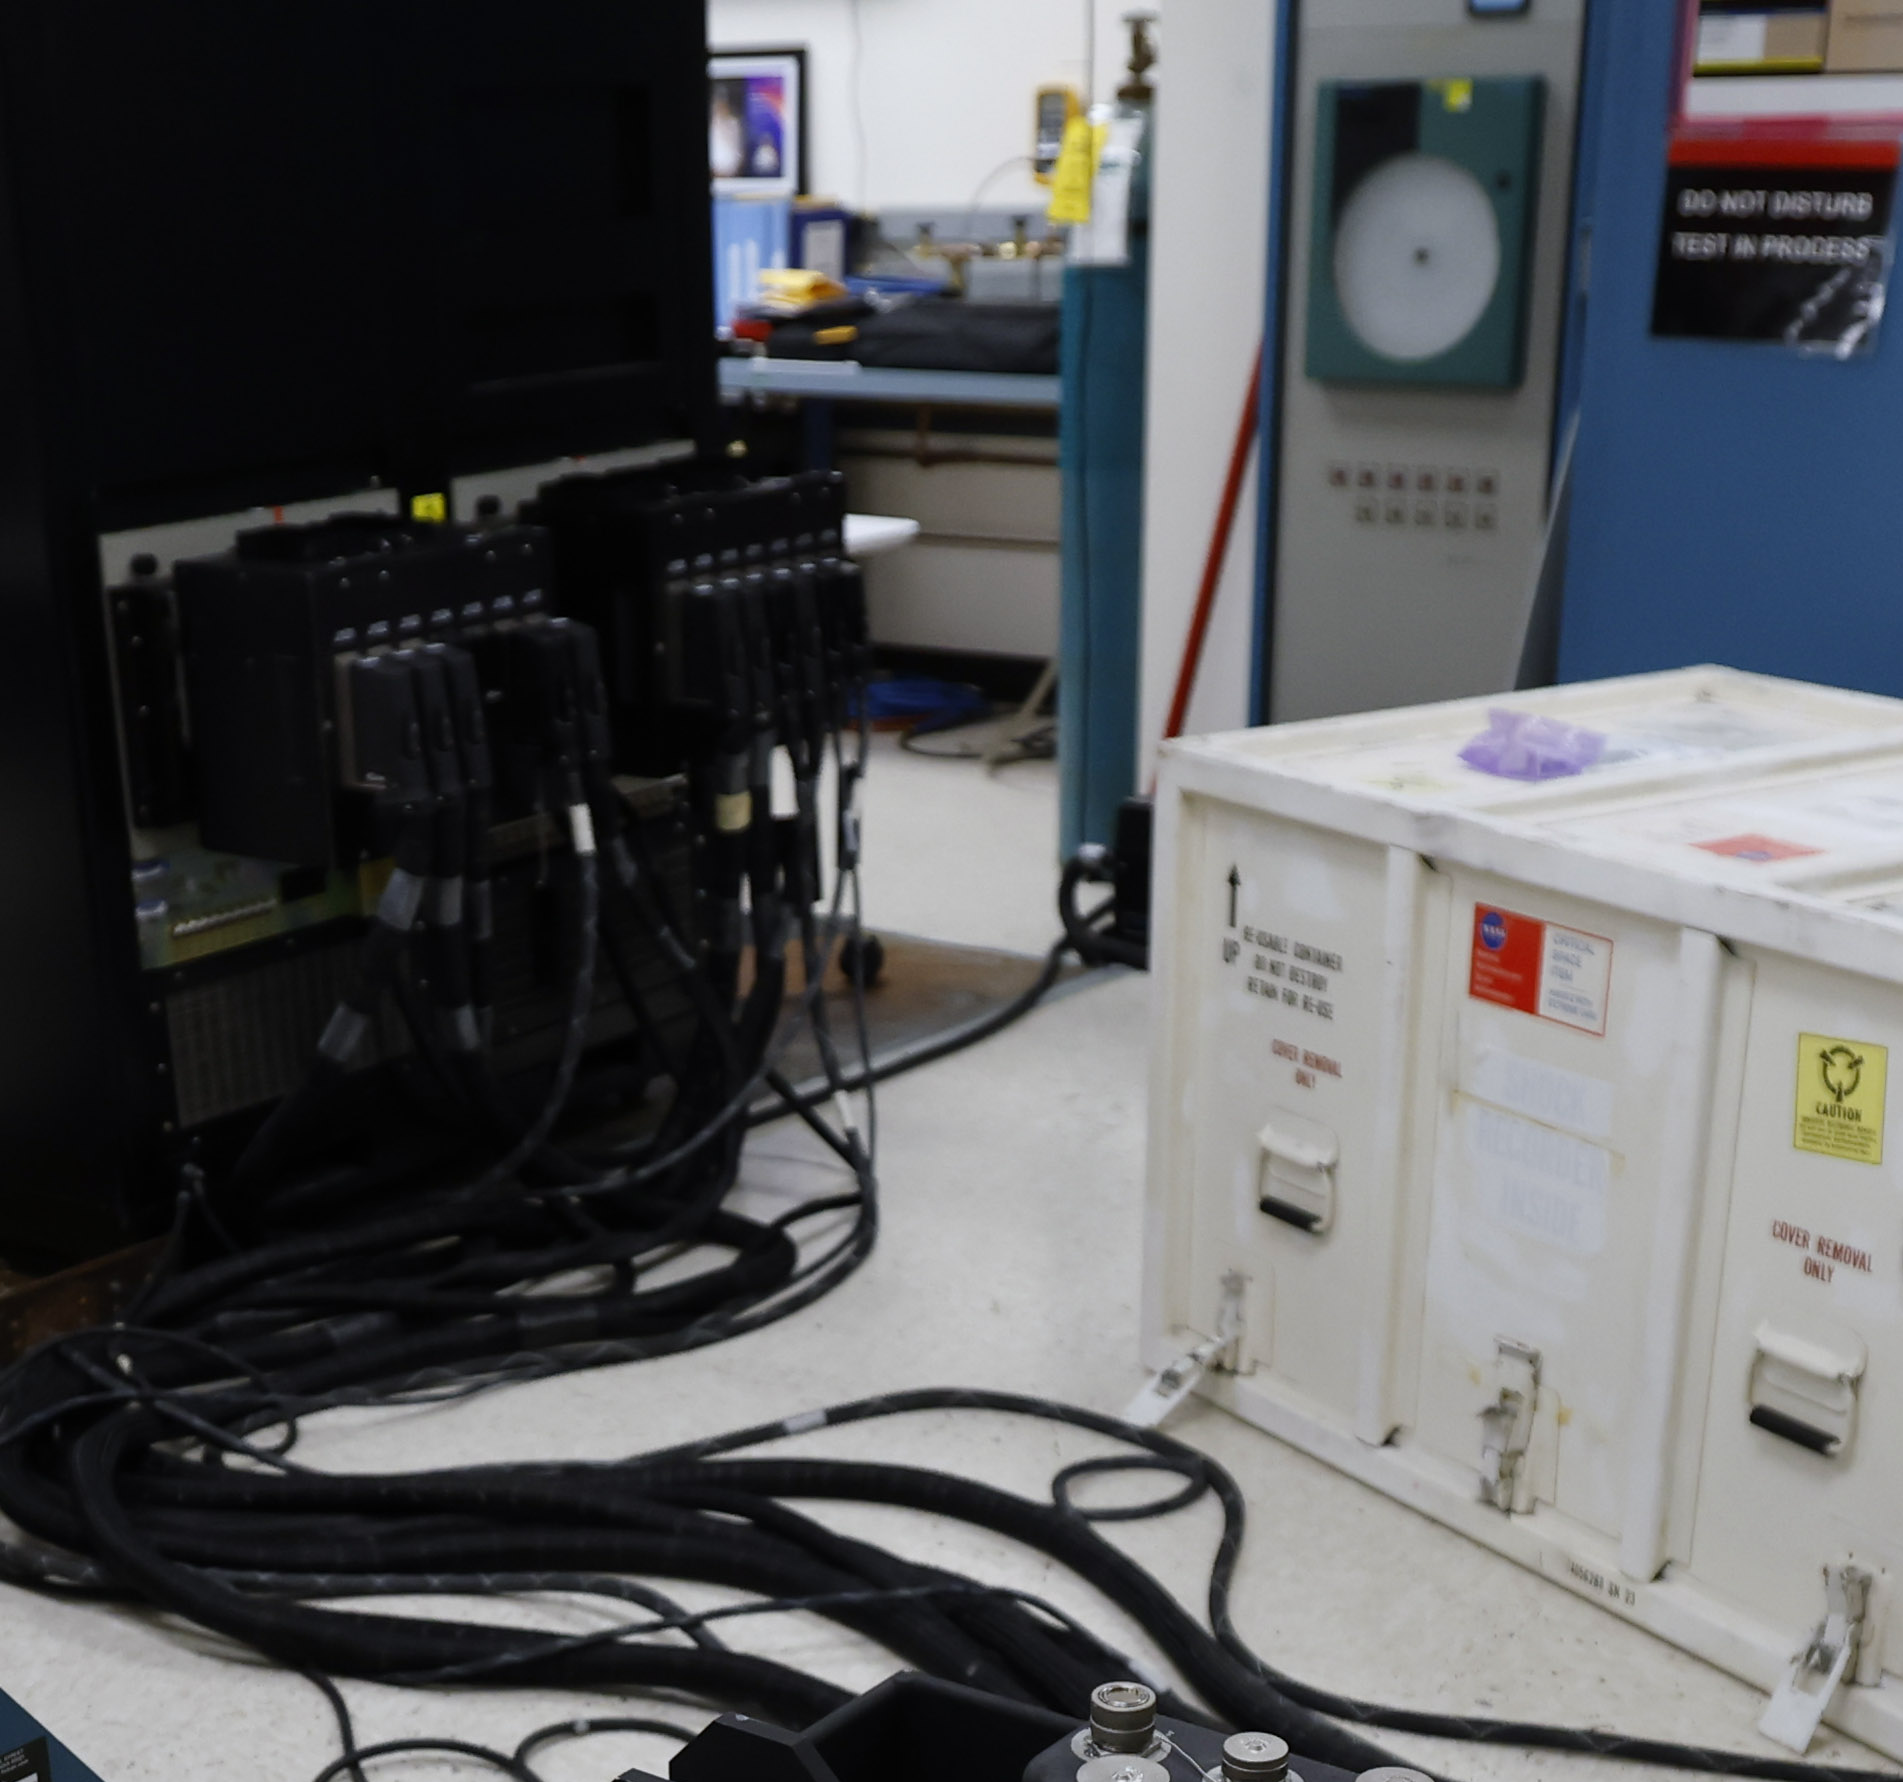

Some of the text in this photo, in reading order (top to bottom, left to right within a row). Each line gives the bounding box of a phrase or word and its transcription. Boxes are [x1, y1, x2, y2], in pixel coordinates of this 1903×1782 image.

[1677, 189, 1873, 222] DO NOT DISTURB
[1671, 232, 1870, 268] TEST IN PROCESS
[1815, 1102, 1862, 1123] CAUTION
[1772, 1219, 1811, 1250] COVER
[1817, 1235, 1873, 1273] REMOVAL
[1803, 1257, 1835, 1283] ONLY
